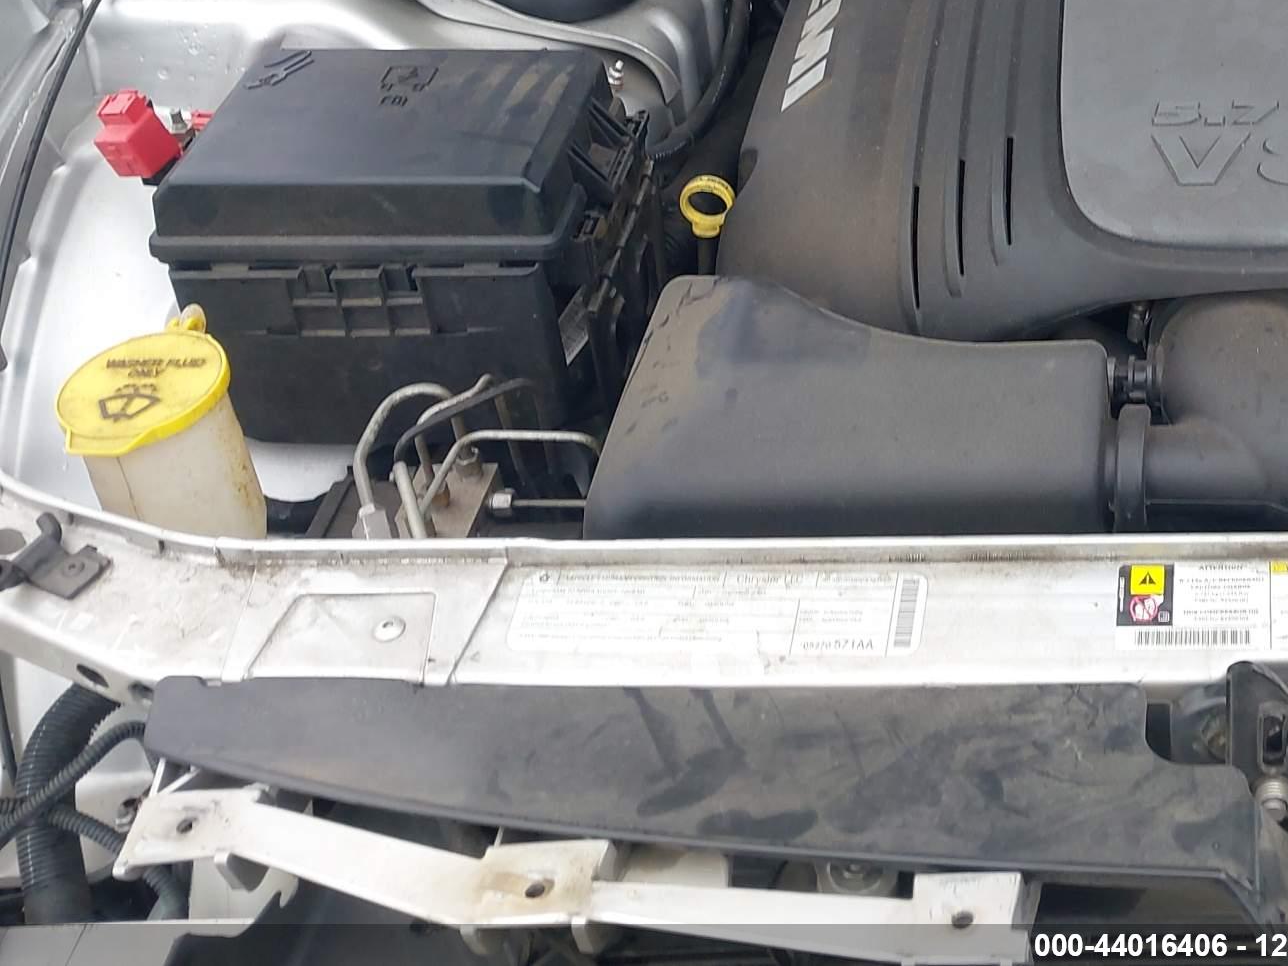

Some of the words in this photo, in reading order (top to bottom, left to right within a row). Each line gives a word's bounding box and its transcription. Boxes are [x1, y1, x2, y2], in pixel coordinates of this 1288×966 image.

[107, 358, 164, 369] WASHER
[166, 357, 206, 369] FLUID
[127, 367, 164, 379] ONLY
